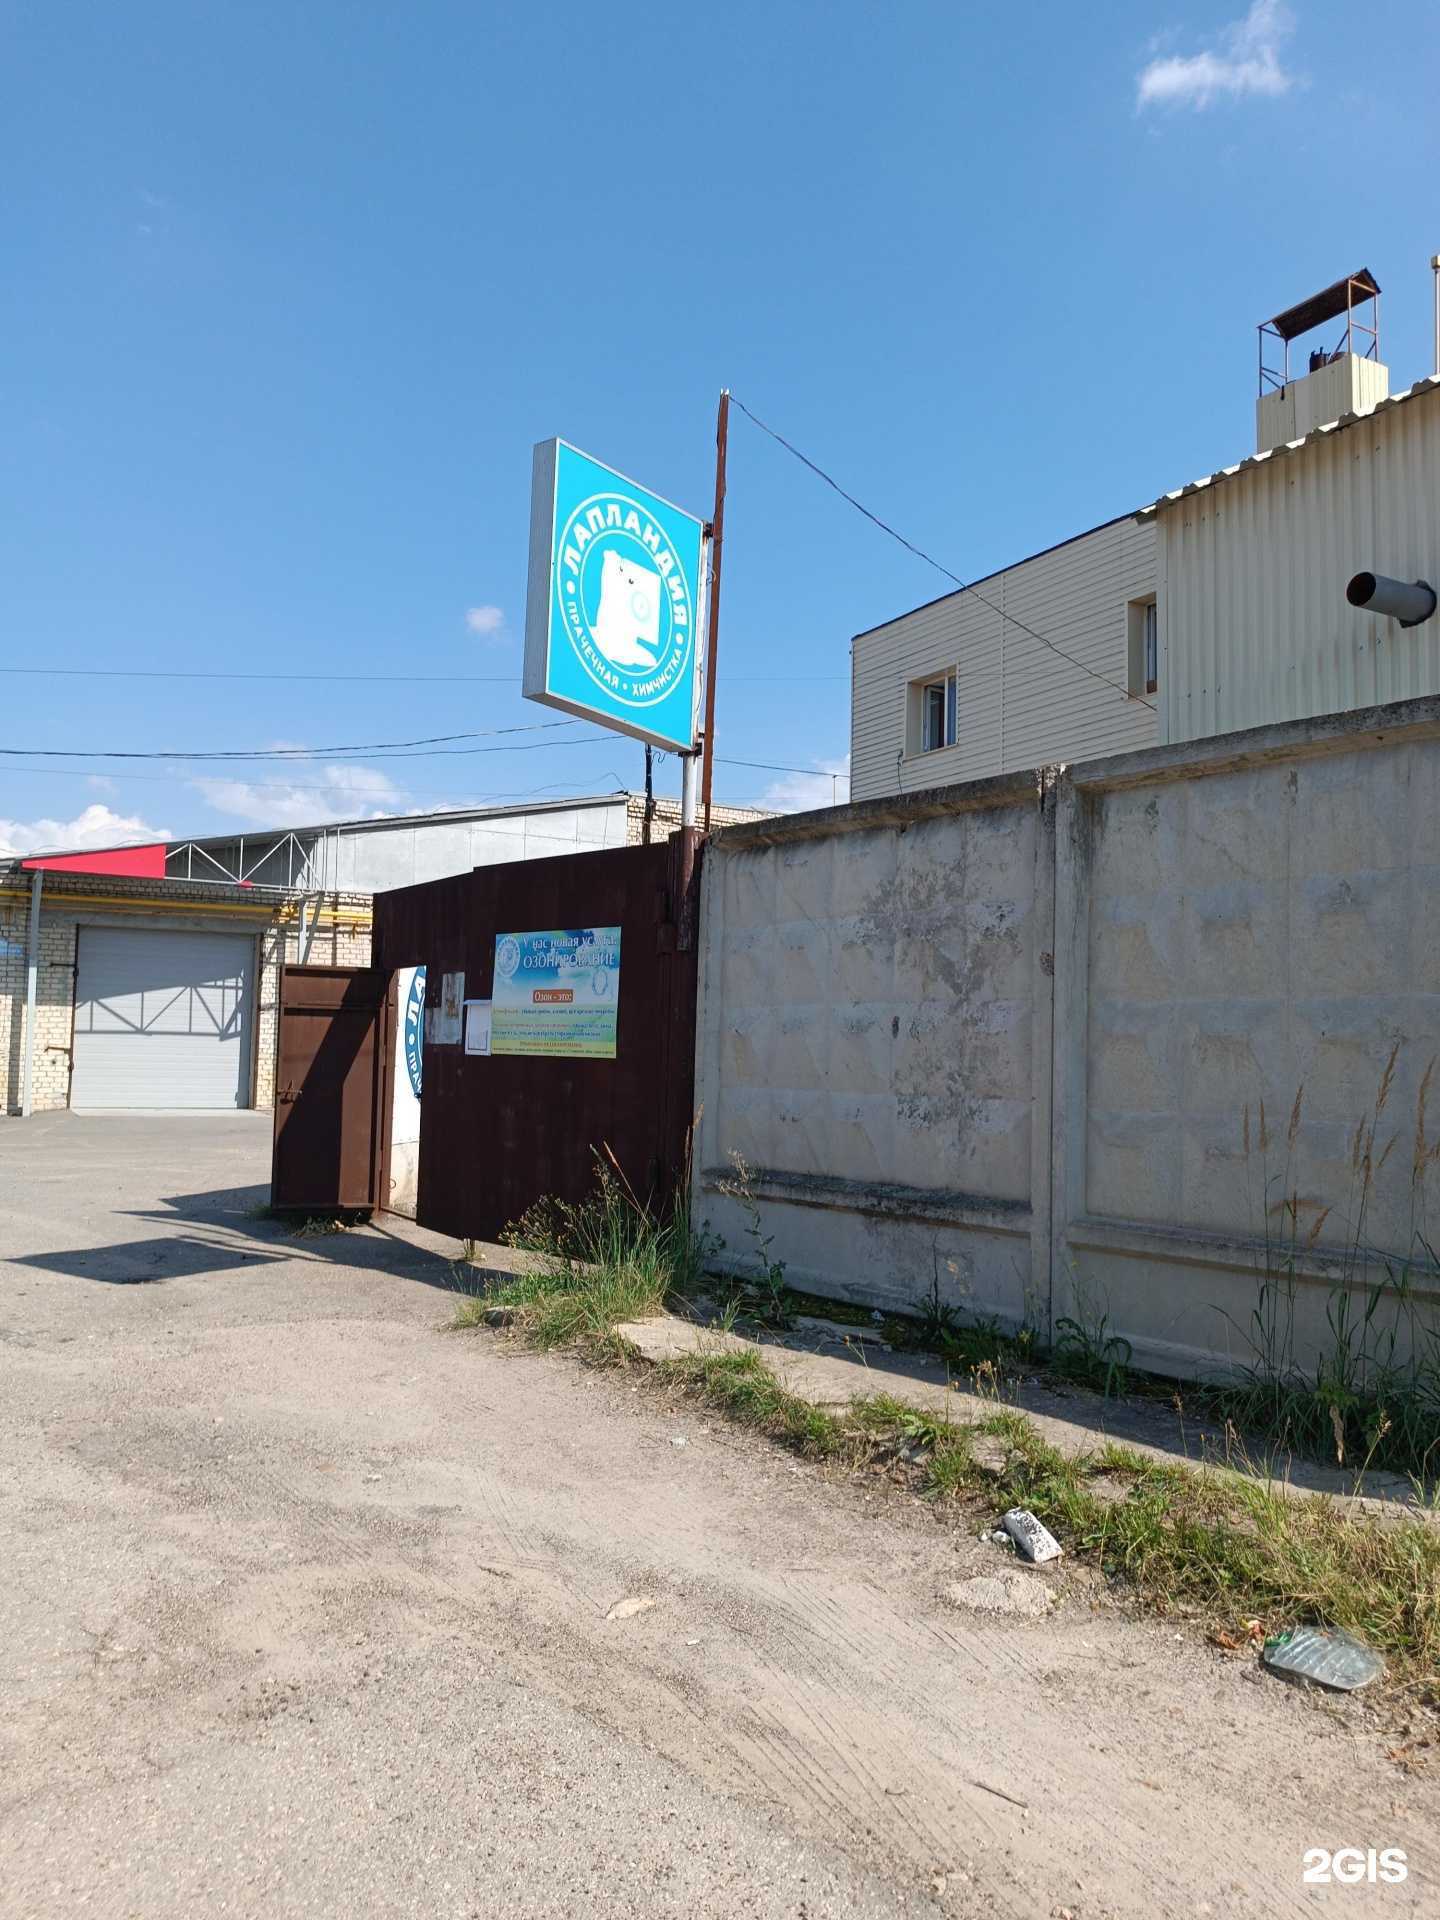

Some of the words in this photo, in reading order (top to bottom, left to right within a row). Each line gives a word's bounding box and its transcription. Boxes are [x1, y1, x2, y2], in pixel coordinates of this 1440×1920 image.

[564, 504, 687, 625] ЛАПЛАНДИЯ
[567, 601, 619, 689] ПРАЧЕЧНАЯ
[632, 648, 682, 697] ХИМЧИСТКА
